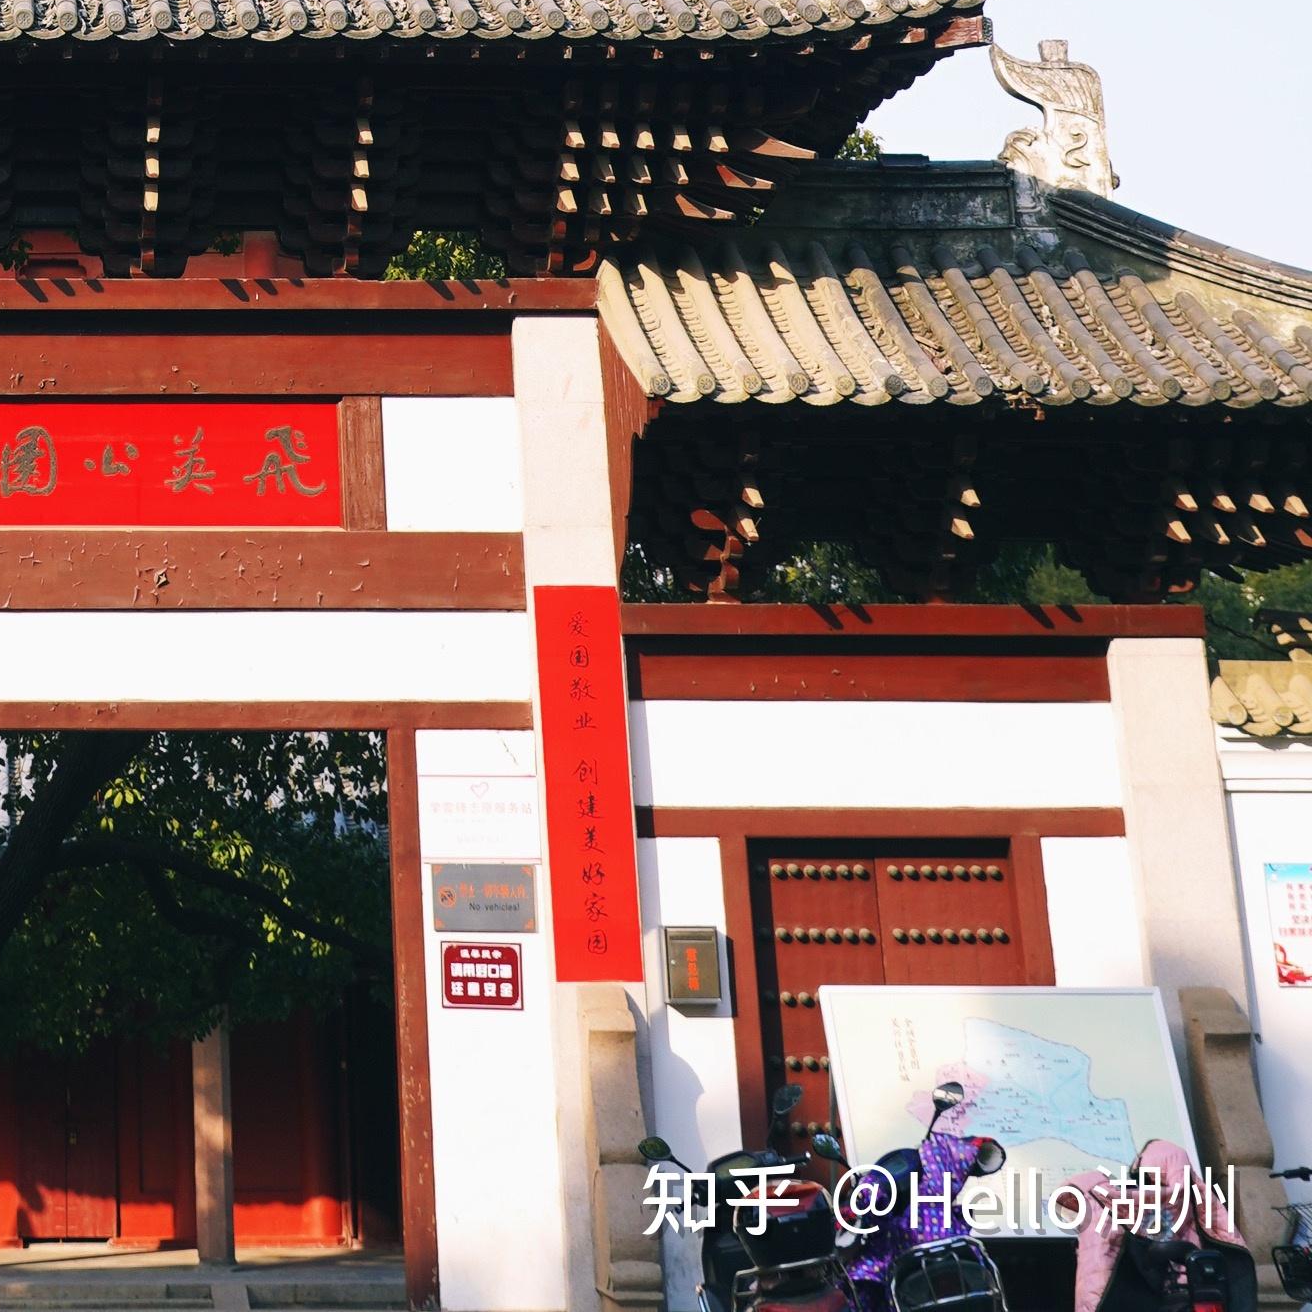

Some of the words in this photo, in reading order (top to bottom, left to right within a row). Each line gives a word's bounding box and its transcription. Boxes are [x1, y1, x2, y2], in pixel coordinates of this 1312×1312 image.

[567, 611, 597, 730] 爱国敬业
[469, 903, 481, 911] No
[575, 760, 607, 954] 创建美好家园
